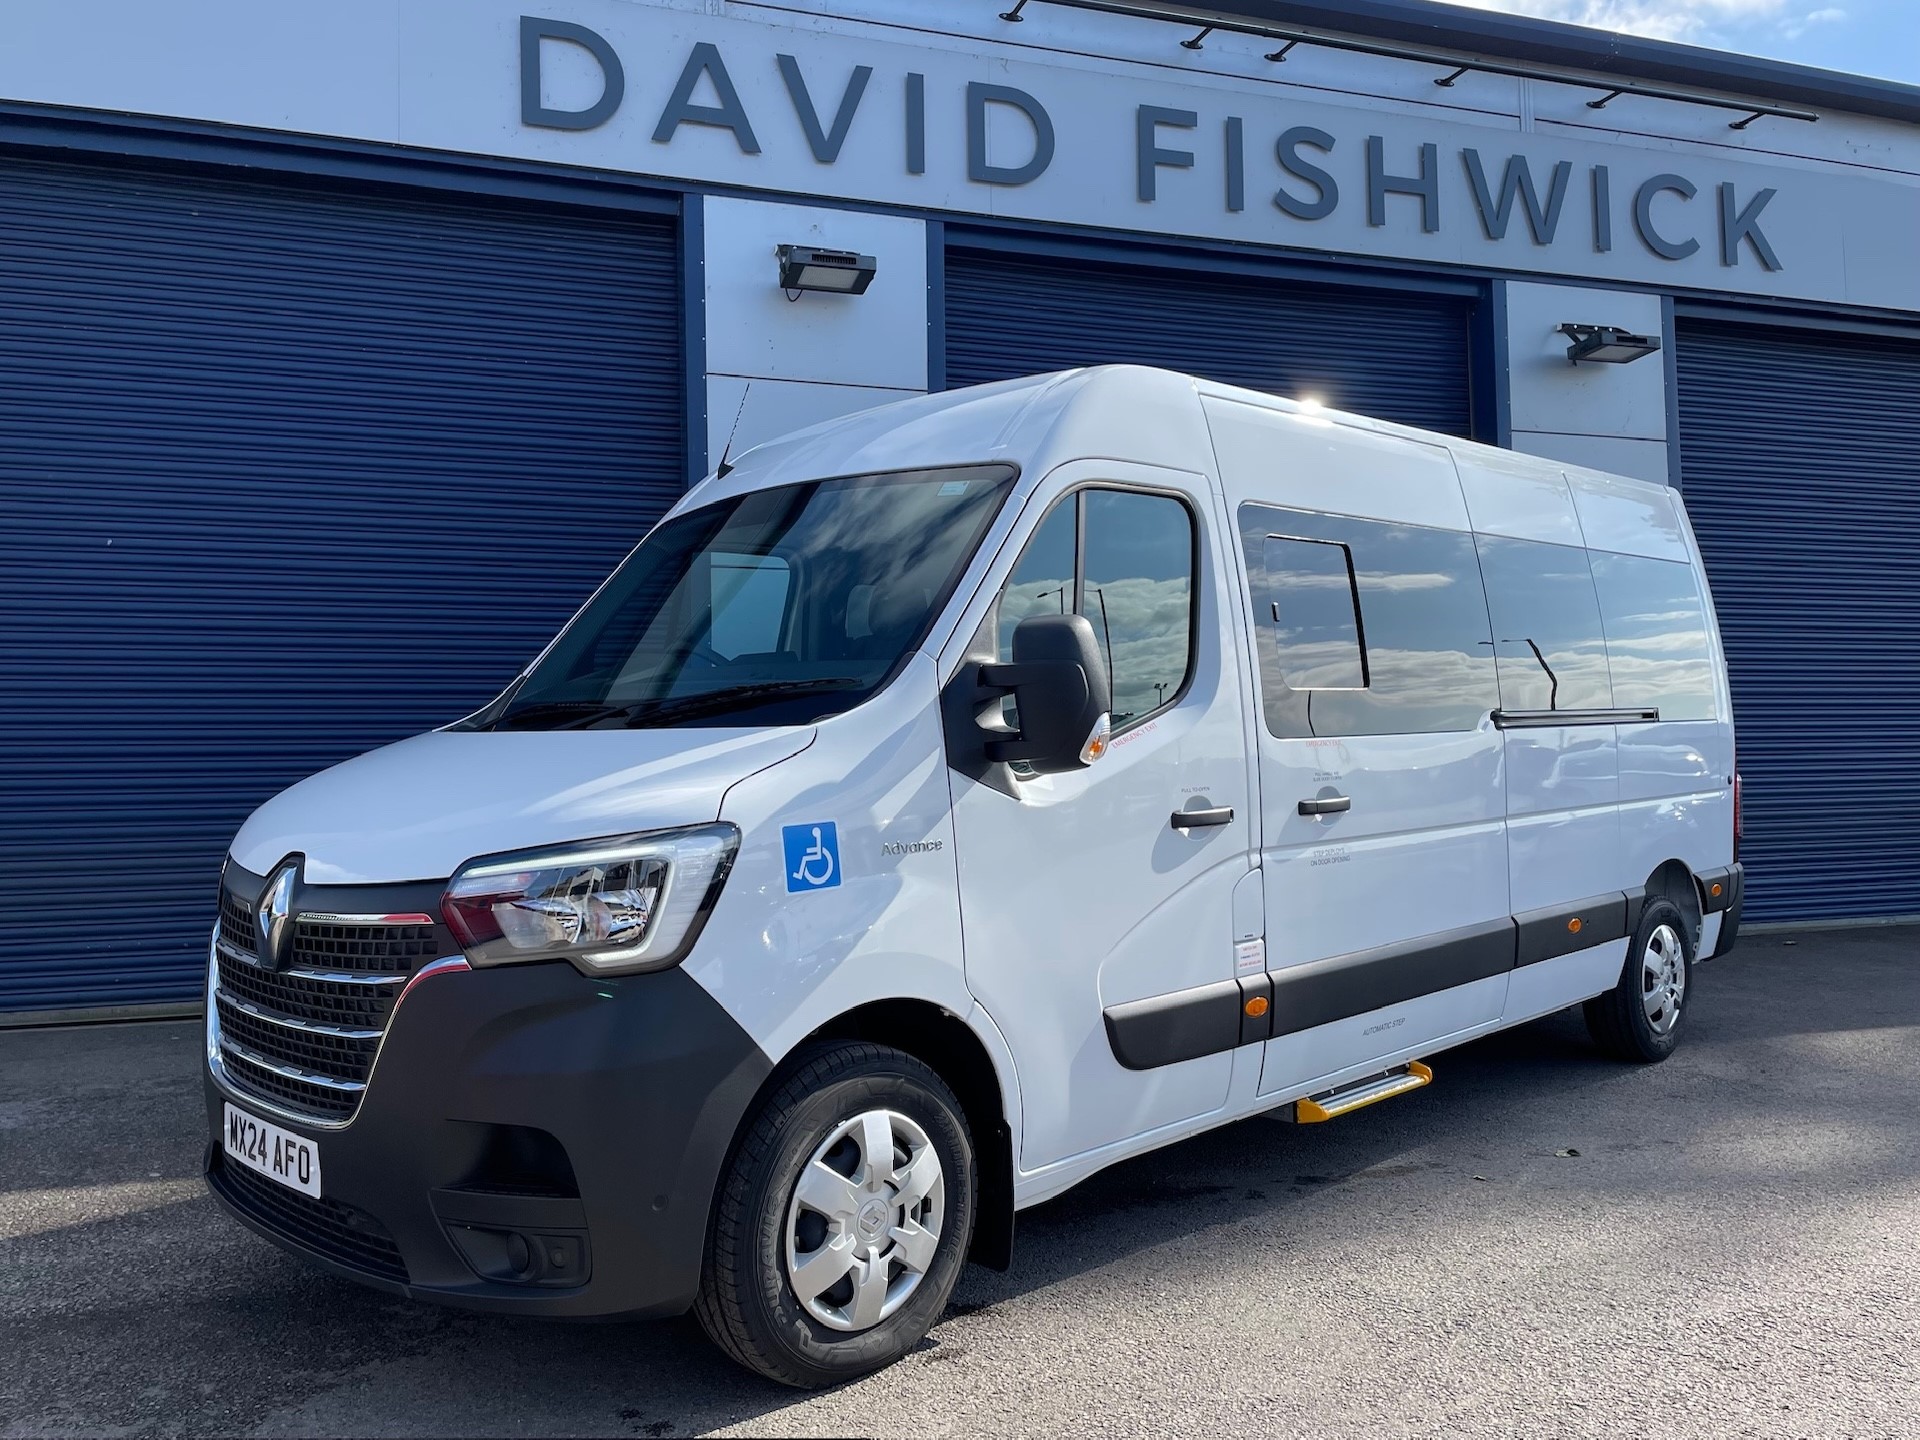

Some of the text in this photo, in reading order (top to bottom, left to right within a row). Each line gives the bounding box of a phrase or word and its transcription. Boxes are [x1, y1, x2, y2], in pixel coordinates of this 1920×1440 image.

[520, 14, 1784, 271] DAVID FISHWICK
[1111, 722, 1158, 749] EMERGENCY EXIT
[881, 839, 943, 856] Advance
[1311, 854, 1351, 867] ON DOOR OPENING
[1363, 1017, 1406, 1036] AUTOMATIC STEP
[230, 1111, 310, 1185] MX24 AFO
[934, 1112, 967, 1264] BRIDGESTONE
[761, 1196, 788, 1327] DURAVIS
